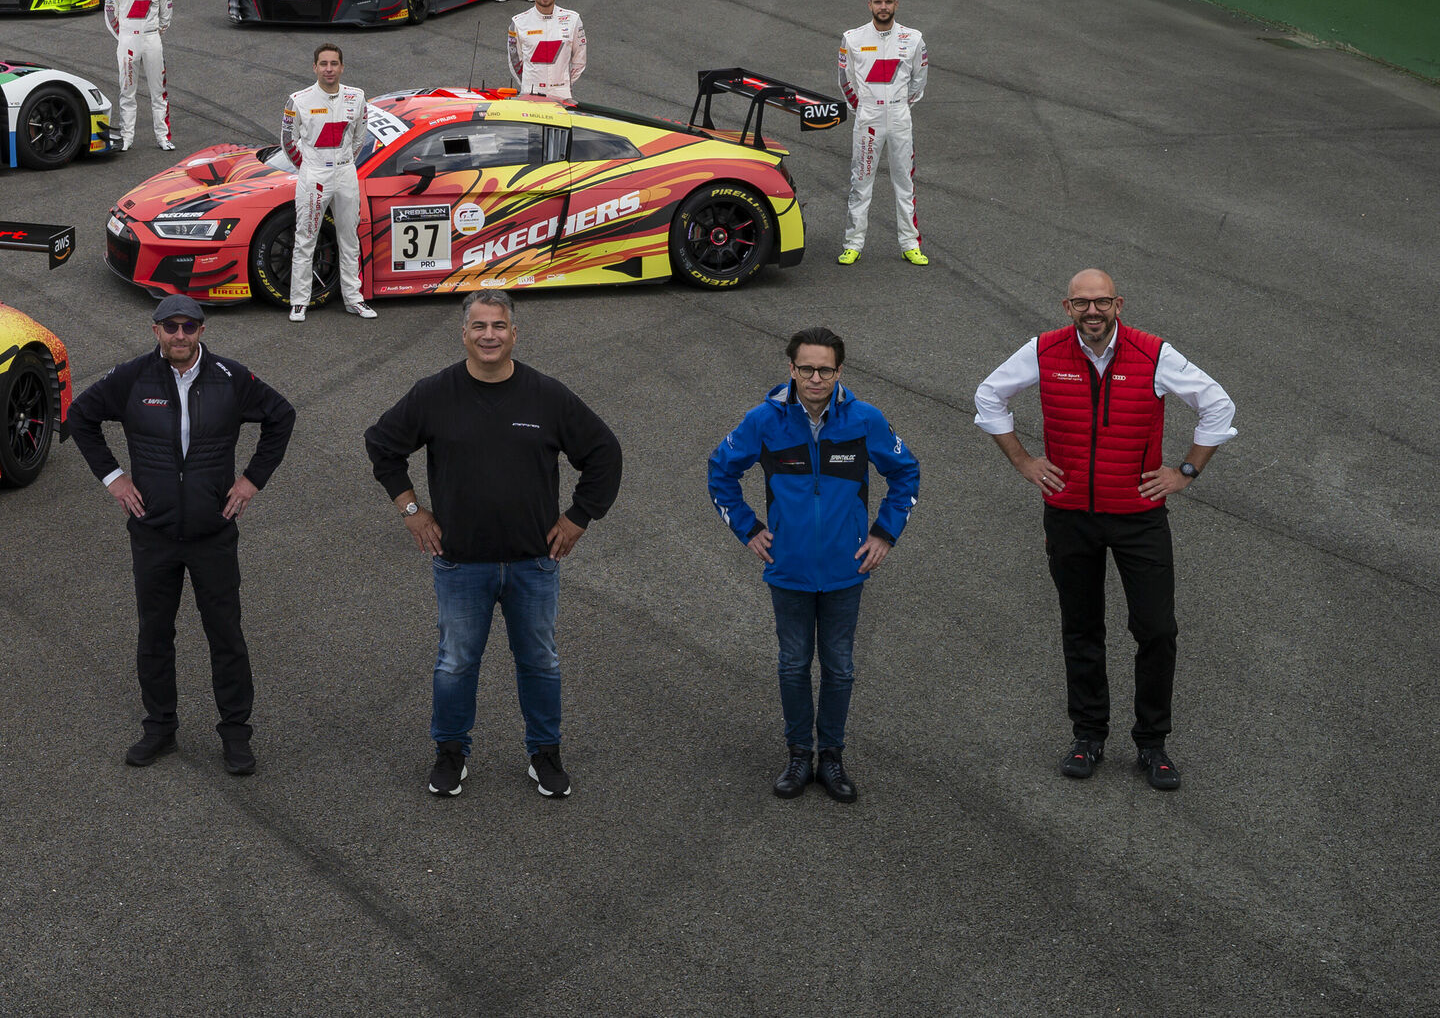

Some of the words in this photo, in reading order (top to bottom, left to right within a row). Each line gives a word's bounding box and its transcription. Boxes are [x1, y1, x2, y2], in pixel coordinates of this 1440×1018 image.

[804, 104, 839, 118] aws
[712, 188, 760, 209] PIRELLI
[462, 190, 641, 270] SKECHERS
[54, 234, 70, 252] aws
[402, 224, 440, 260] 37
[420, 260, 436, 268] PRO
[212, 285, 250, 296] PIRELLI
